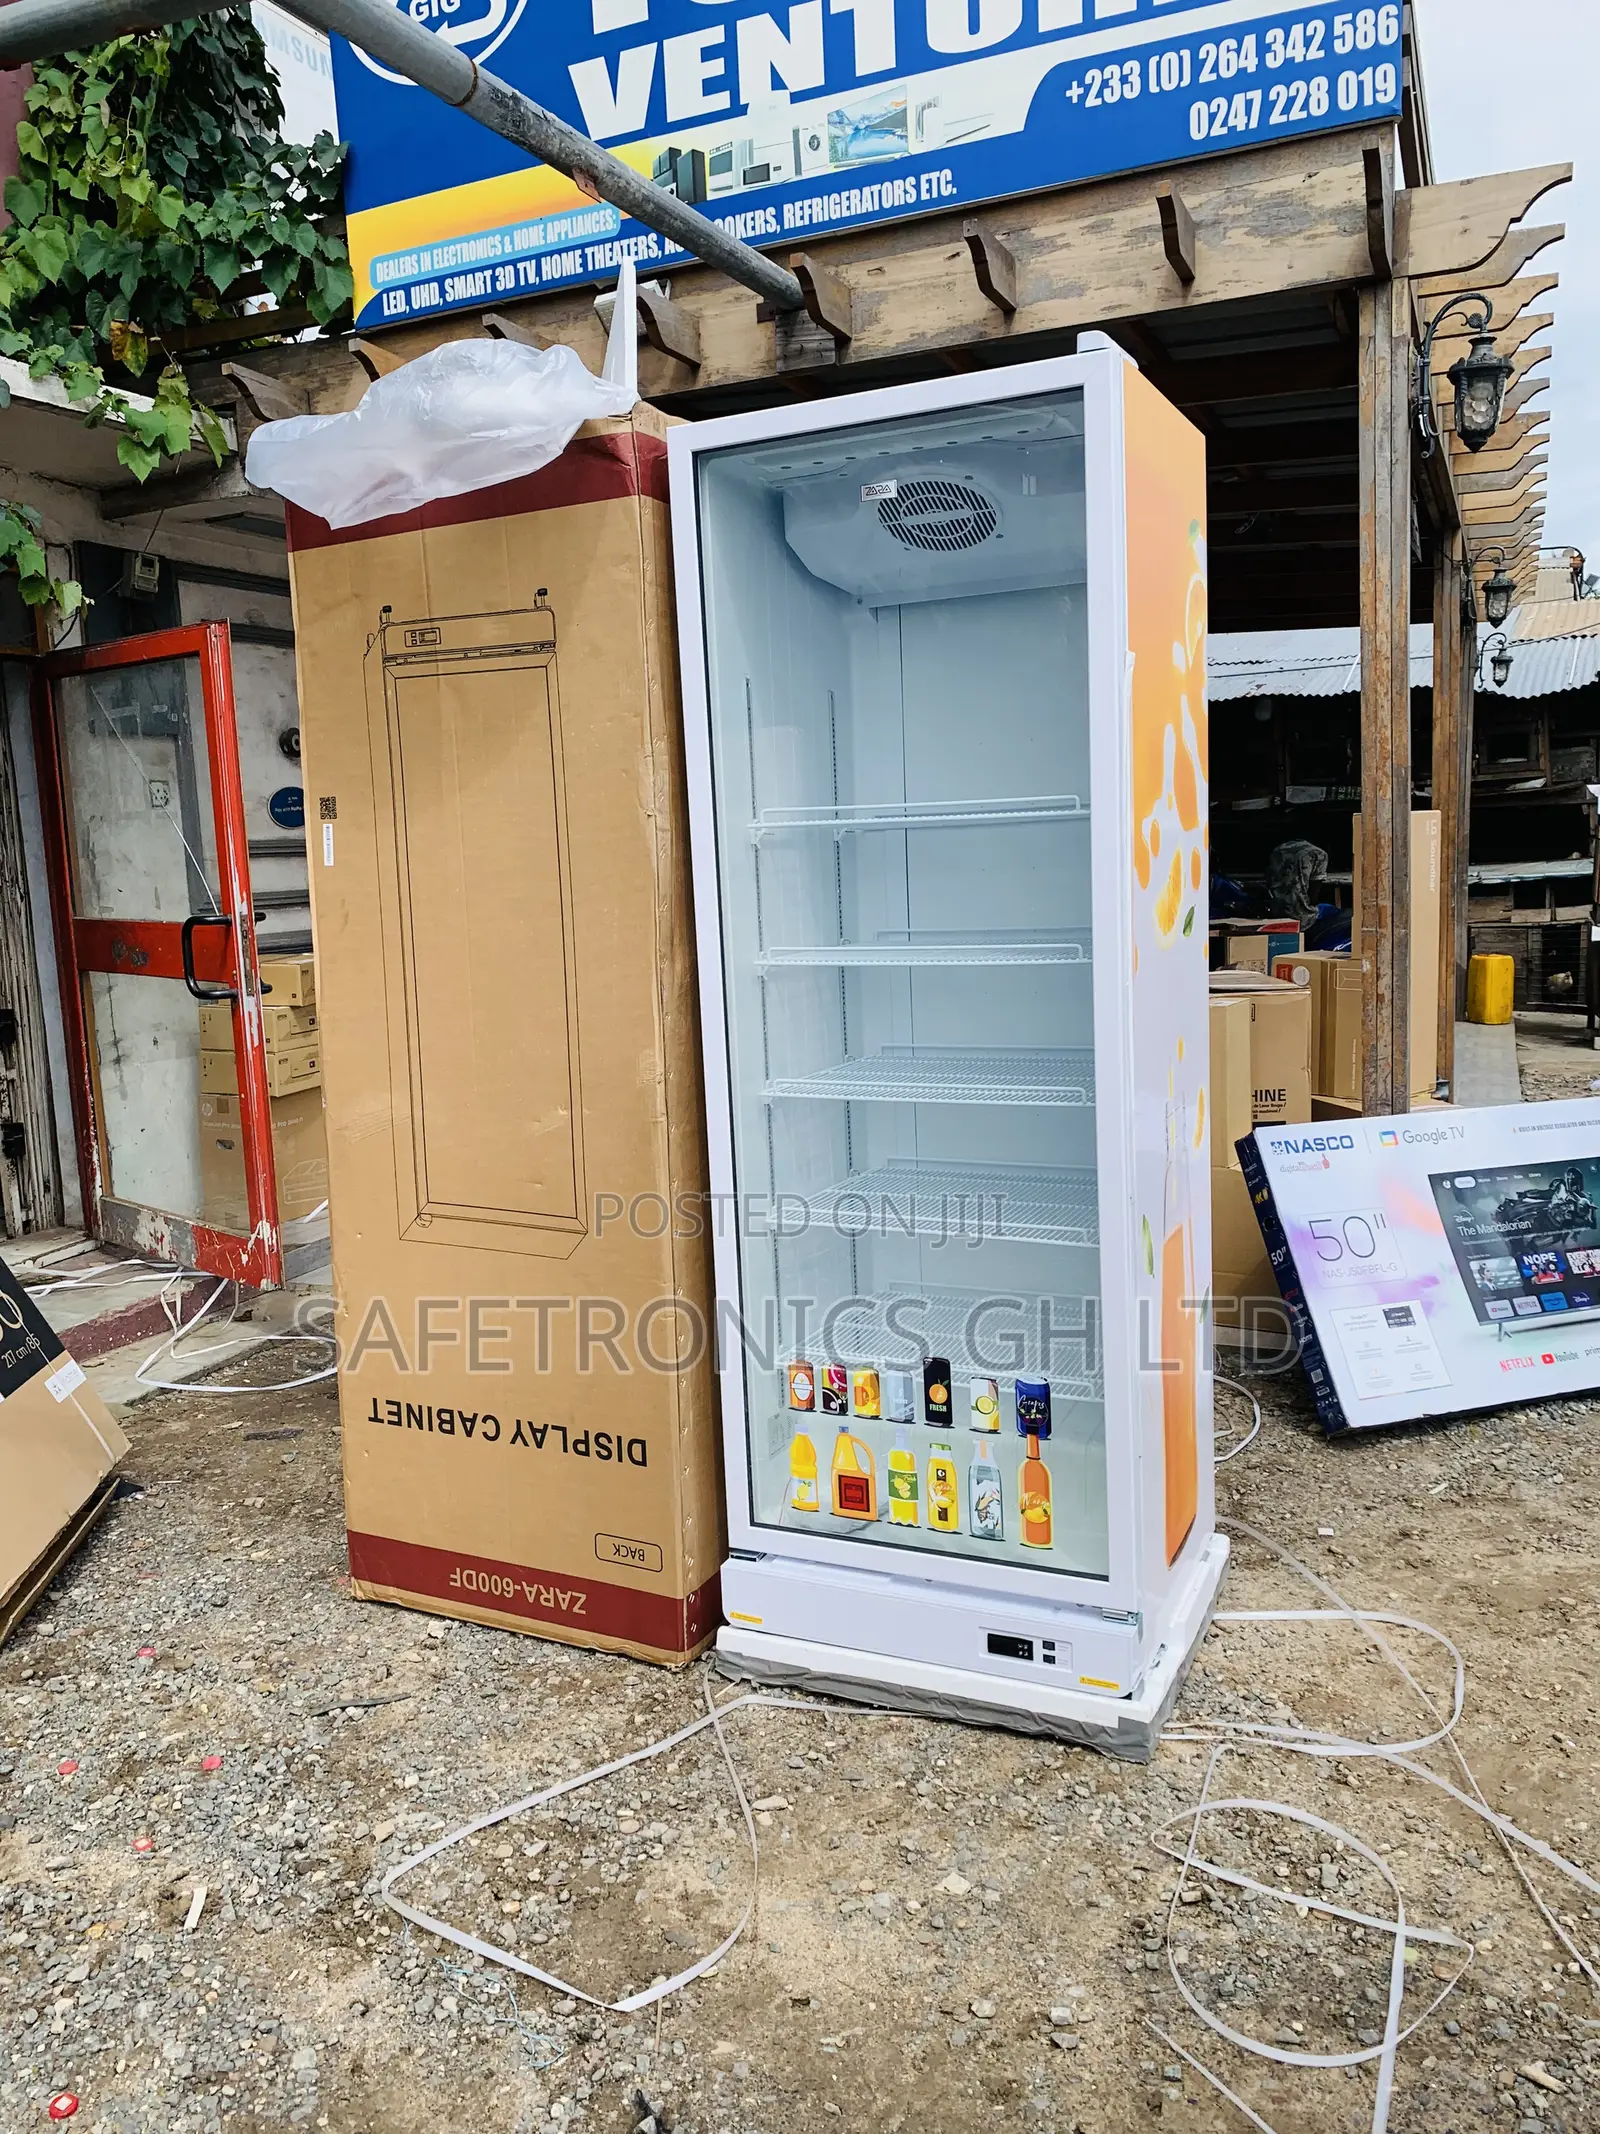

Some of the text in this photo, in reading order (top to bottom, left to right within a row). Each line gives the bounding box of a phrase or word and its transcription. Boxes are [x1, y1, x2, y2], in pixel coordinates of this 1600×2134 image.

[1066, 4, 1399, 109] +233 (0) 264 342 586
[1189, 62, 1397, 141] 0247 228 019
[376, 208, 617, 283] DEALERS IN ELECTRONICS & HOME APPLIANCES:
[383, 288, 410, 316] LED,
[411, 281, 443, 310] UHD,
[445, 271, 492, 302] SMART
[496, 267, 515, 289] 3D
[517, 262, 539, 286] TV,
[542, 255, 583, 281] HOME
[784, 175, 917, 229] REFRIGERATORS
[920, 168, 957, 200] ETC.
[1284, 1135, 1354, 1154] NASCO
[1402, 1126, 1465, 1144] Google TV
[1308, 1213, 1387, 1261] 50"
[1457, 1225, 1477, 1238] The
[1477, 1220, 1532, 1234] Mandalorian
[1522, 1252, 1558, 1266] NOPE
[1500, 1356, 1536, 1372] NETFLIX
[929, 1404, 947, 1412] FRESH
[368, 1397, 648, 1467] DISPLAY CABINET
[612, 1542, 645, 1562] BACK
[449, 1567, 587, 1615] ZARA-600DF
